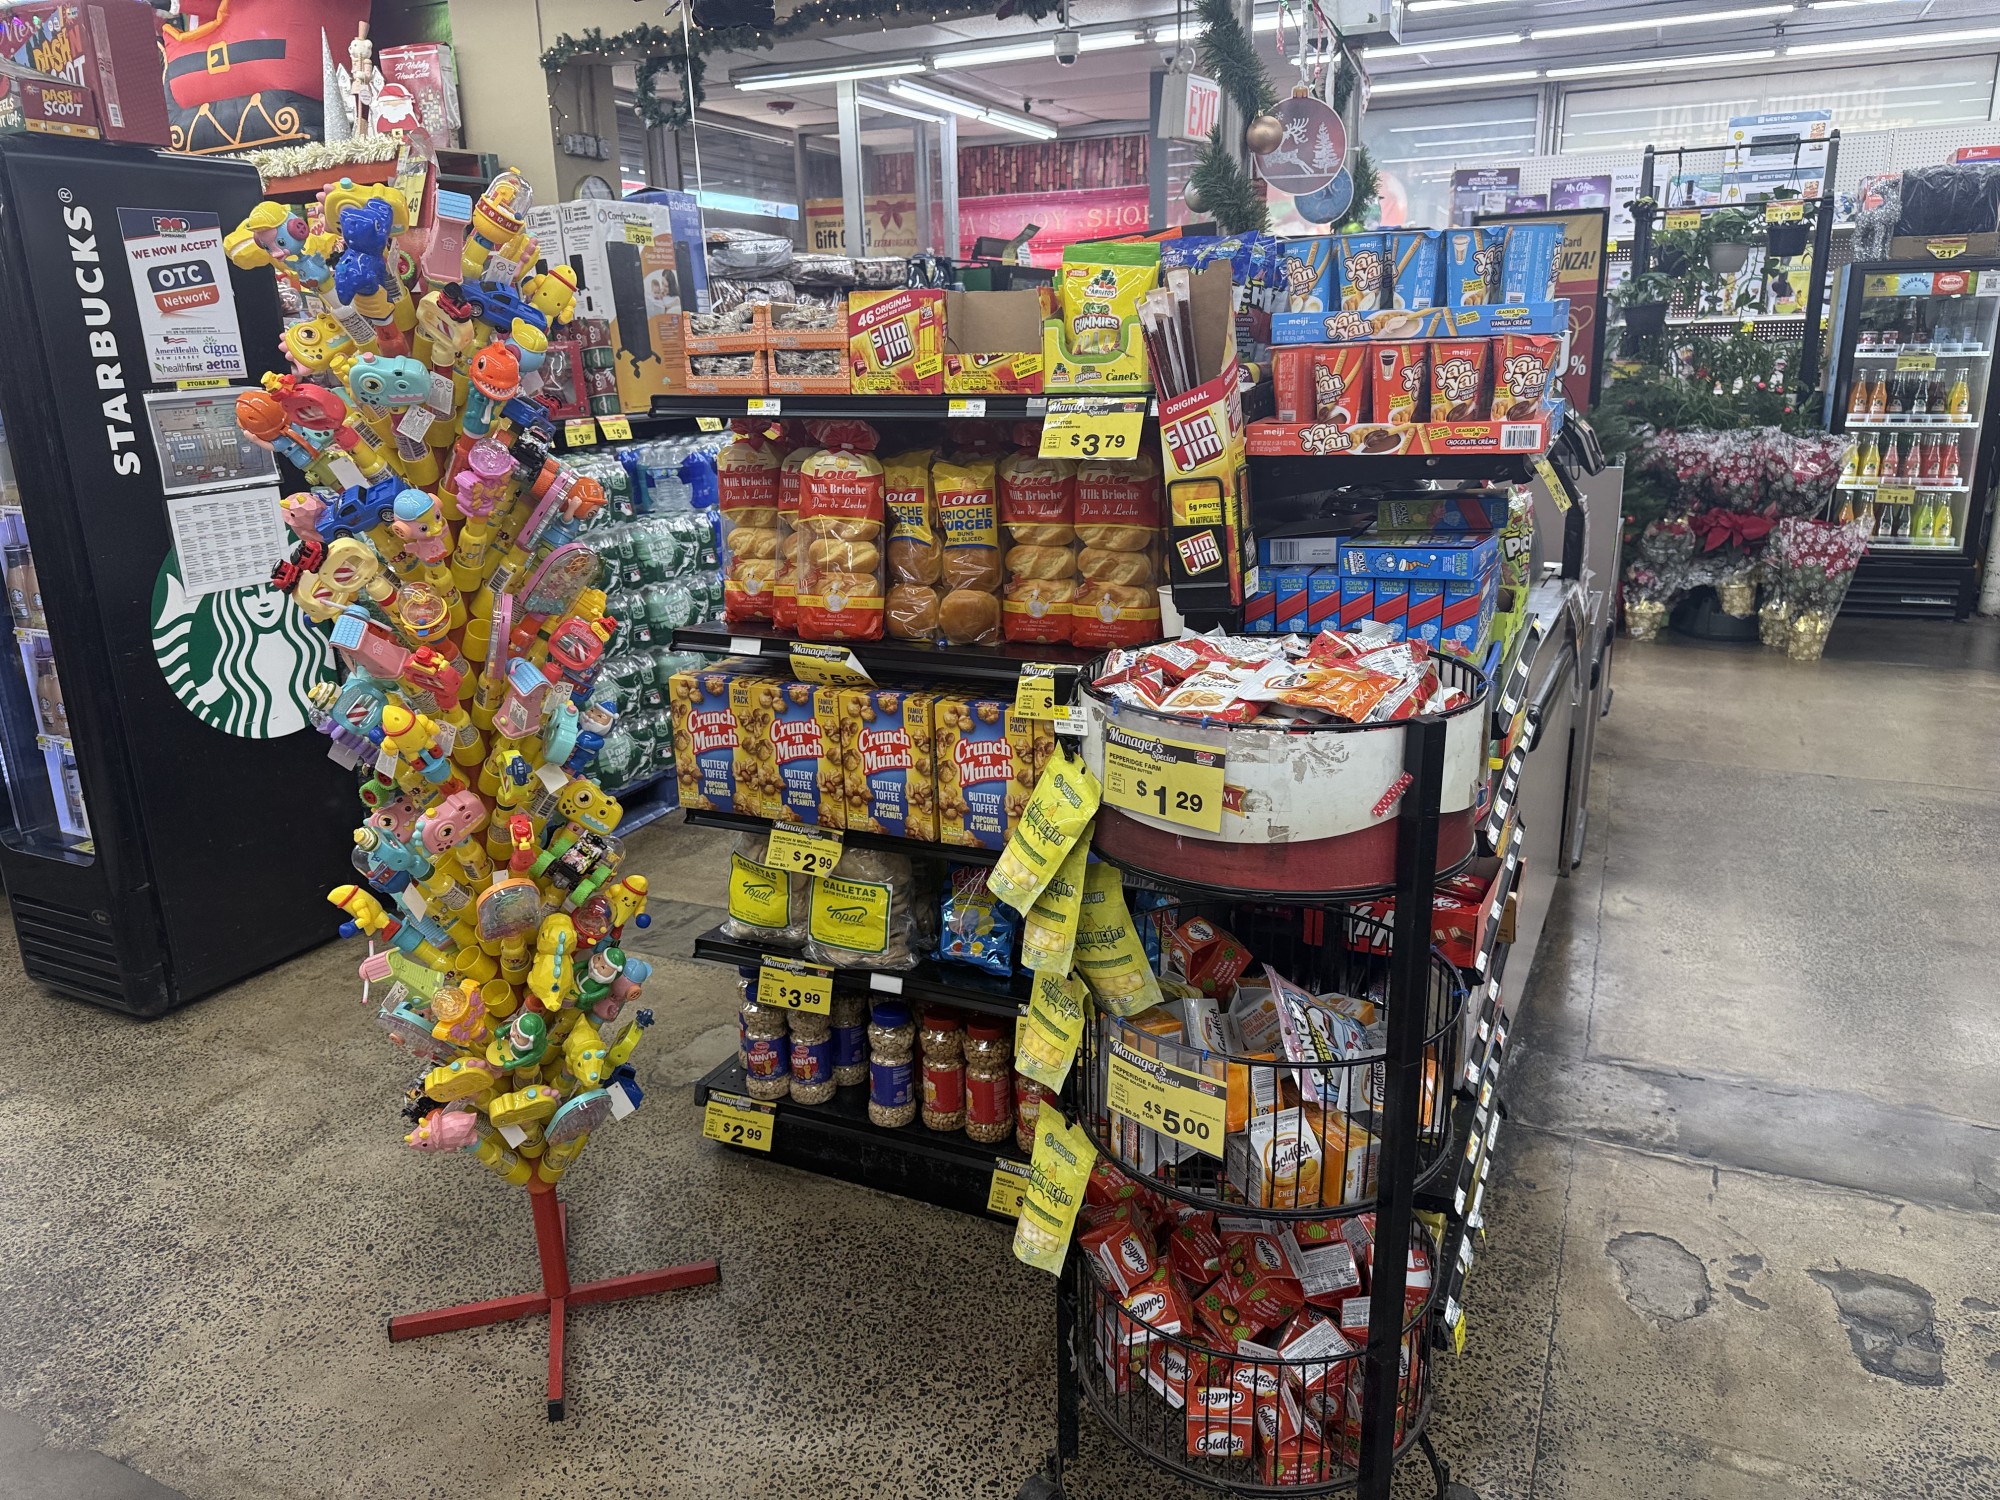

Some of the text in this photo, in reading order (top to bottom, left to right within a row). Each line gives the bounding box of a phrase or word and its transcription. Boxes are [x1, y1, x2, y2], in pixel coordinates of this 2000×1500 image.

[406, 61, 430, 72] Holiday
[42, 89, 82, 104] DASH N
[44, 101, 83, 117] SCOOT
[1188, 85, 1218, 141] EXIT
[1765, 114, 1797, 123] WEST BEND
[1615, 173, 1639, 181] BOSALY
[1759, 172, 1791, 181] WEST BEND
[1576, 182, 1596, 192] Coffee
[815, 230, 839, 248] Gift
[1563, 236, 1582, 248] Card
[132, 239, 218, 260] WE NOW ACCEPT
[158, 265, 203, 287] OTC
[1901, 275, 1930, 290] MINERAGUA
[163, 291, 211, 307] Network
[858, 295, 911, 327] 46 ORIGINAL
[1074, 316, 1120, 332] GUMMIES
[1288, 317, 1310, 326] meiji
[63, 205, 141, 476] STARBUCKS
[155, 346, 199, 355] AmeriHealth
[203, 344, 238, 357] cigna
[1452, 349, 1472, 357] meiji
[1524, 345, 1544, 353] meiji
[163, 362, 203, 373] healthfirst
[206, 359, 240, 370] aetna
[1503, 355, 1541, 383] Yan
[1106, 372, 1140, 382] Canel's
[1048, 400, 1099, 414] Manager's
[1166, 390, 1210, 415] ORIGINAL
[1089, 409, 1109, 417] Special
[1264, 428, 1285, 437] meiji
[1300, 424, 1337, 451] Yan
[1446, 438, 1476, 446] CHOCOLATE
[723, 476, 772, 487] Milk Brioche
[811, 483, 867, 494] Milk Brioche
[1024, 489, 1063, 500] Brioche
[1080, 489, 1139, 500] Milk Brioche
[724, 489, 773, 501] Pan Leche
[812, 496, 867, 509] Pan de Leche
[1188, 503, 1198, 512] 6g
[940, 507, 993, 521] BRIOCHE
[1037, 502, 1063, 516] Leche
[1080, 503, 1139, 516] Pan de Leche
[1400, 502, 1409, 523] JOLLY
[1196, 514, 1215, 524] ARTIFICIAL
[732, 688, 748, 696] FAMILY
[733, 695, 749, 704] PACK
[818, 705, 834, 714] PACK
[688, 709, 737, 732] Crunch
[907, 714, 924, 723] PACK
[771, 719, 821, 741] Crunch
[1009, 724, 1027, 733] PACK
[693, 732, 738, 752] Munch
[859, 729, 910, 750] Crunch
[1109, 727, 1164, 753] Manager's
[776, 740, 823, 763] Munch
[955, 740, 1012, 762] Crunch
[1151, 750, 1177, 764] Special
[701, 759, 729, 770] BUTTERY
[864, 750, 911, 774] Munch
[1109, 752, 1162, 772] PEPPERIDGE FARM
[705, 768, 727, 779] TOFFEE
[784, 769, 813, 780] BUTTERY
[960, 764, 1013, 786] Munch
[1137, 766, 1153, 775] BUTTER
[705, 780, 728, 788] POPCORN
[788, 779, 812, 790] TOFFEE
[871, 780, 902, 791] BUTTERY
[709, 788, 731, 797] PEANUTS
[789, 791, 812, 800] POPCORN
[875, 790, 899, 801] TOFFEE
[968, 792, 1001, 804] BUTTERY
[792, 798, 815, 807] PEANUTS
[876, 803, 899, 812] POPCORN
[972, 803, 998, 814] TOFFEE
[880, 811, 902, 820] PEANUTS
[973, 815, 999, 824] POPCORN
[976, 823, 1001, 833] PEANUTS
[1038, 819, 1066, 846] HEADS
[737, 859, 777, 880] GALLETAS
[743, 881, 776, 901] Topal
[823, 880, 877, 897] GALLETAS
[836, 891, 849, 899] STYLE
[826, 905, 868, 924] Topal
[1095, 926, 1126, 944] HEADS
[1113, 1041, 1167, 1077] Manager's
[1112, 1064, 1165, 1093] PEPPERIDGE FARM
[1154, 1072, 1180, 1087] Special
[1111, 1101, 1124, 1111] Save
[1143, 1100, 1153, 1112] 4
[1142, 1110, 1155, 1120] FOR
[1271, 1141, 1312, 1171] Goldfish
[996, 1176, 1015, 1185] BOGOPA
[1046, 1181, 1073, 1206] HEADS
[1120, 1236, 1149, 1274] Goldfish
[1255, 1236, 1281, 1271] Goldfish
[1196, 1436, 1244, 1451] Goldfish
